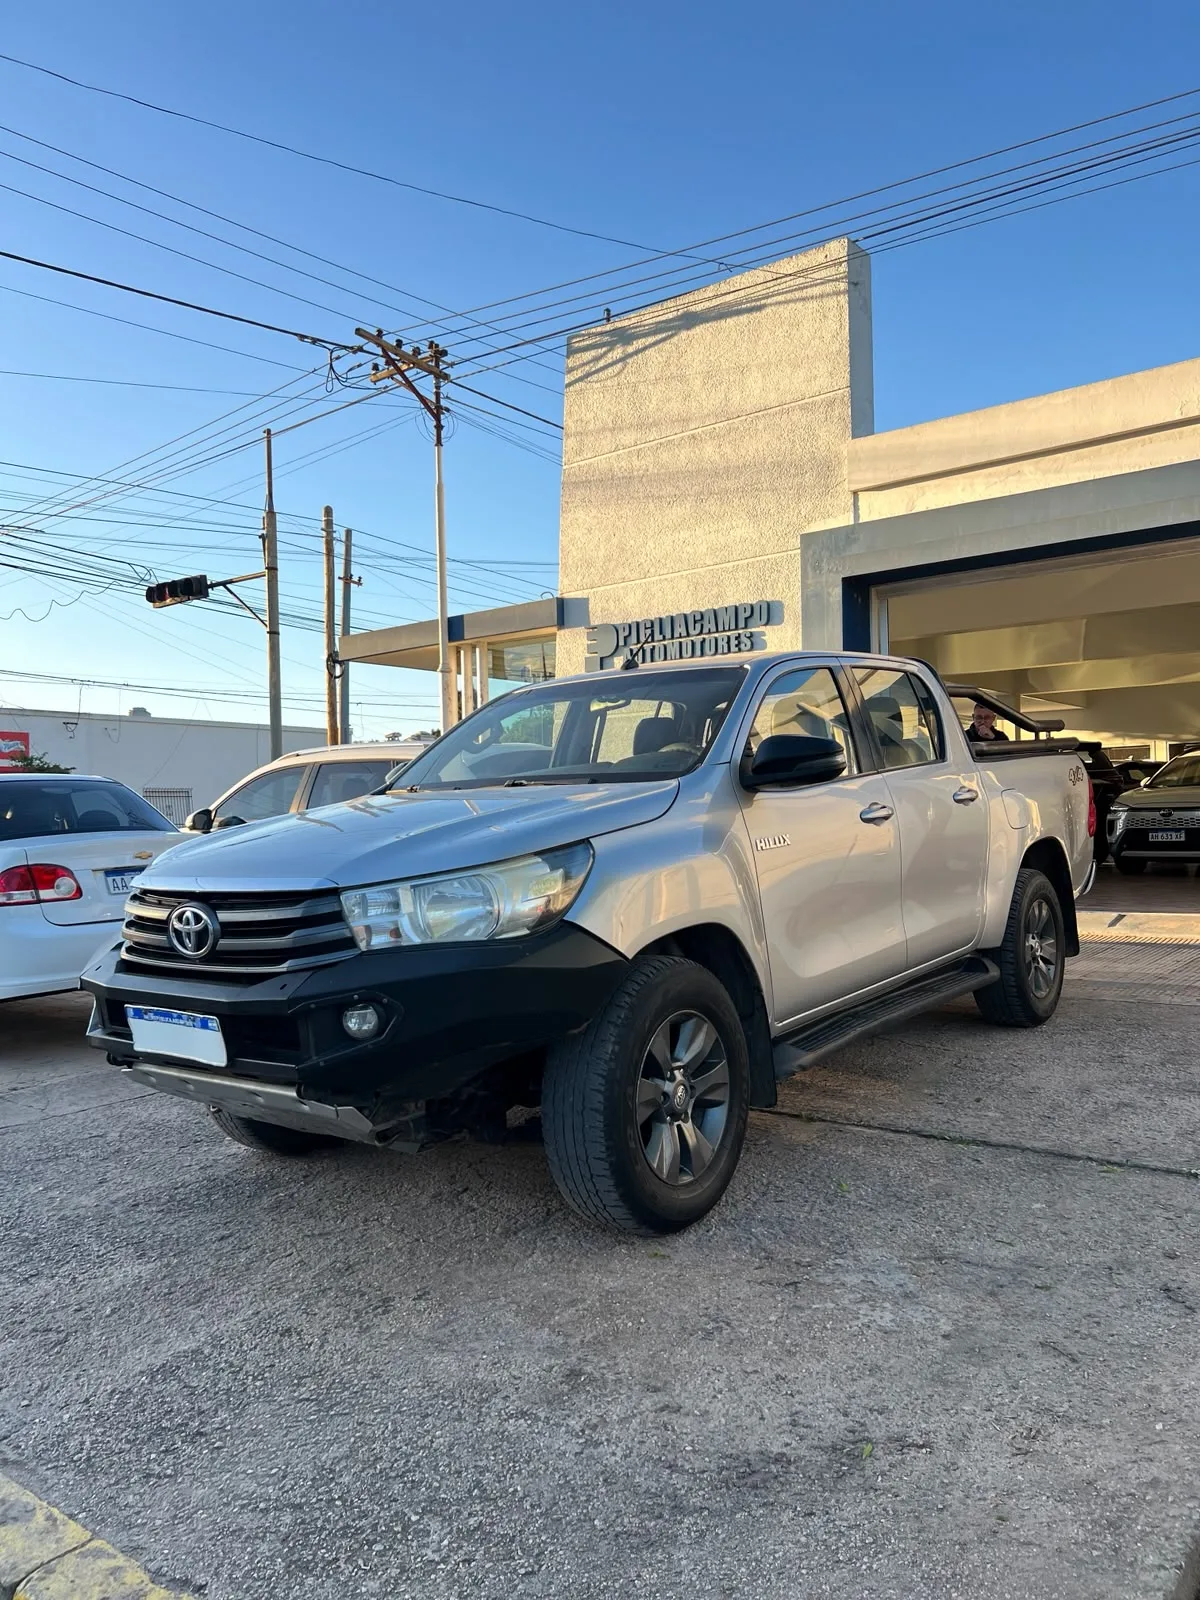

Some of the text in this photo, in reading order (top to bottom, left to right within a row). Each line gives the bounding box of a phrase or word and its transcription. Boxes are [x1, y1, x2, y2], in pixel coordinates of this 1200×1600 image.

[618, 601, 769, 646] PIGLIACAMPO
[755, 833, 791, 851] HILUX
[112, 877, 128, 891] AA
